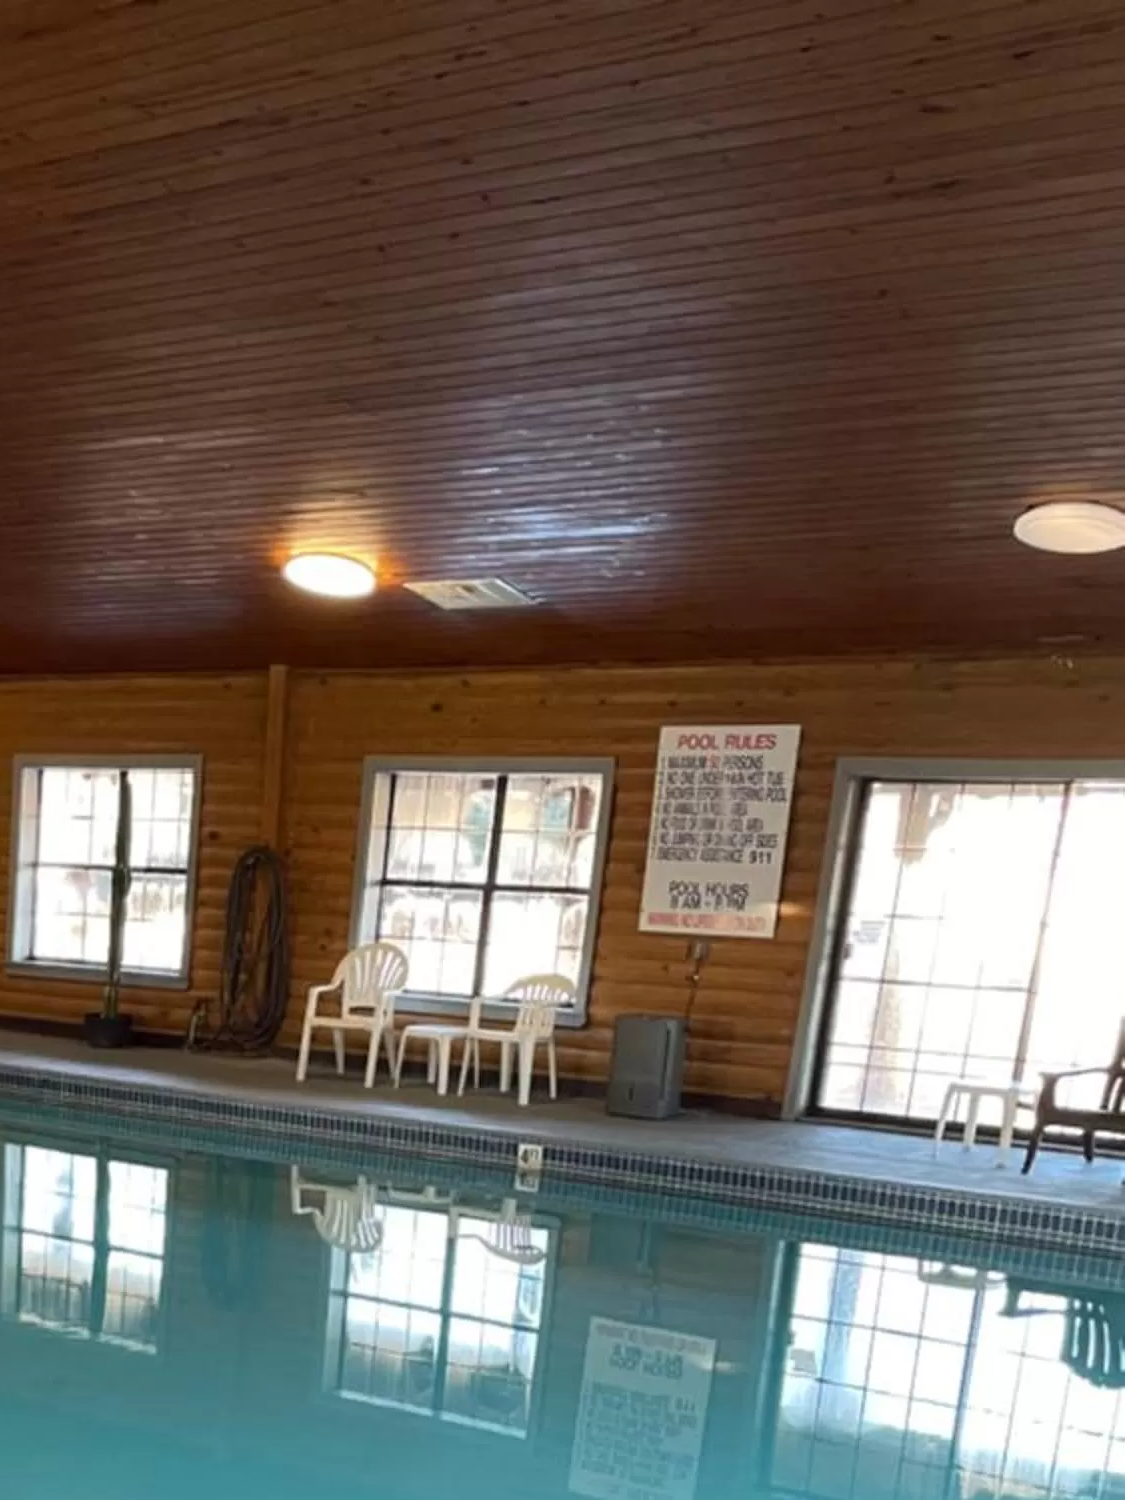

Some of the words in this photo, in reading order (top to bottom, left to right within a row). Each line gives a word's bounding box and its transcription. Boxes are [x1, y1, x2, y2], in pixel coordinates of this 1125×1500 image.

[677, 734, 718, 750] POOL
[725, 734, 778, 750] RULES
[749, 850, 772, 865] 911
[668, 880, 700, 895] POOL
[705, 882, 749, 897] HOURS
